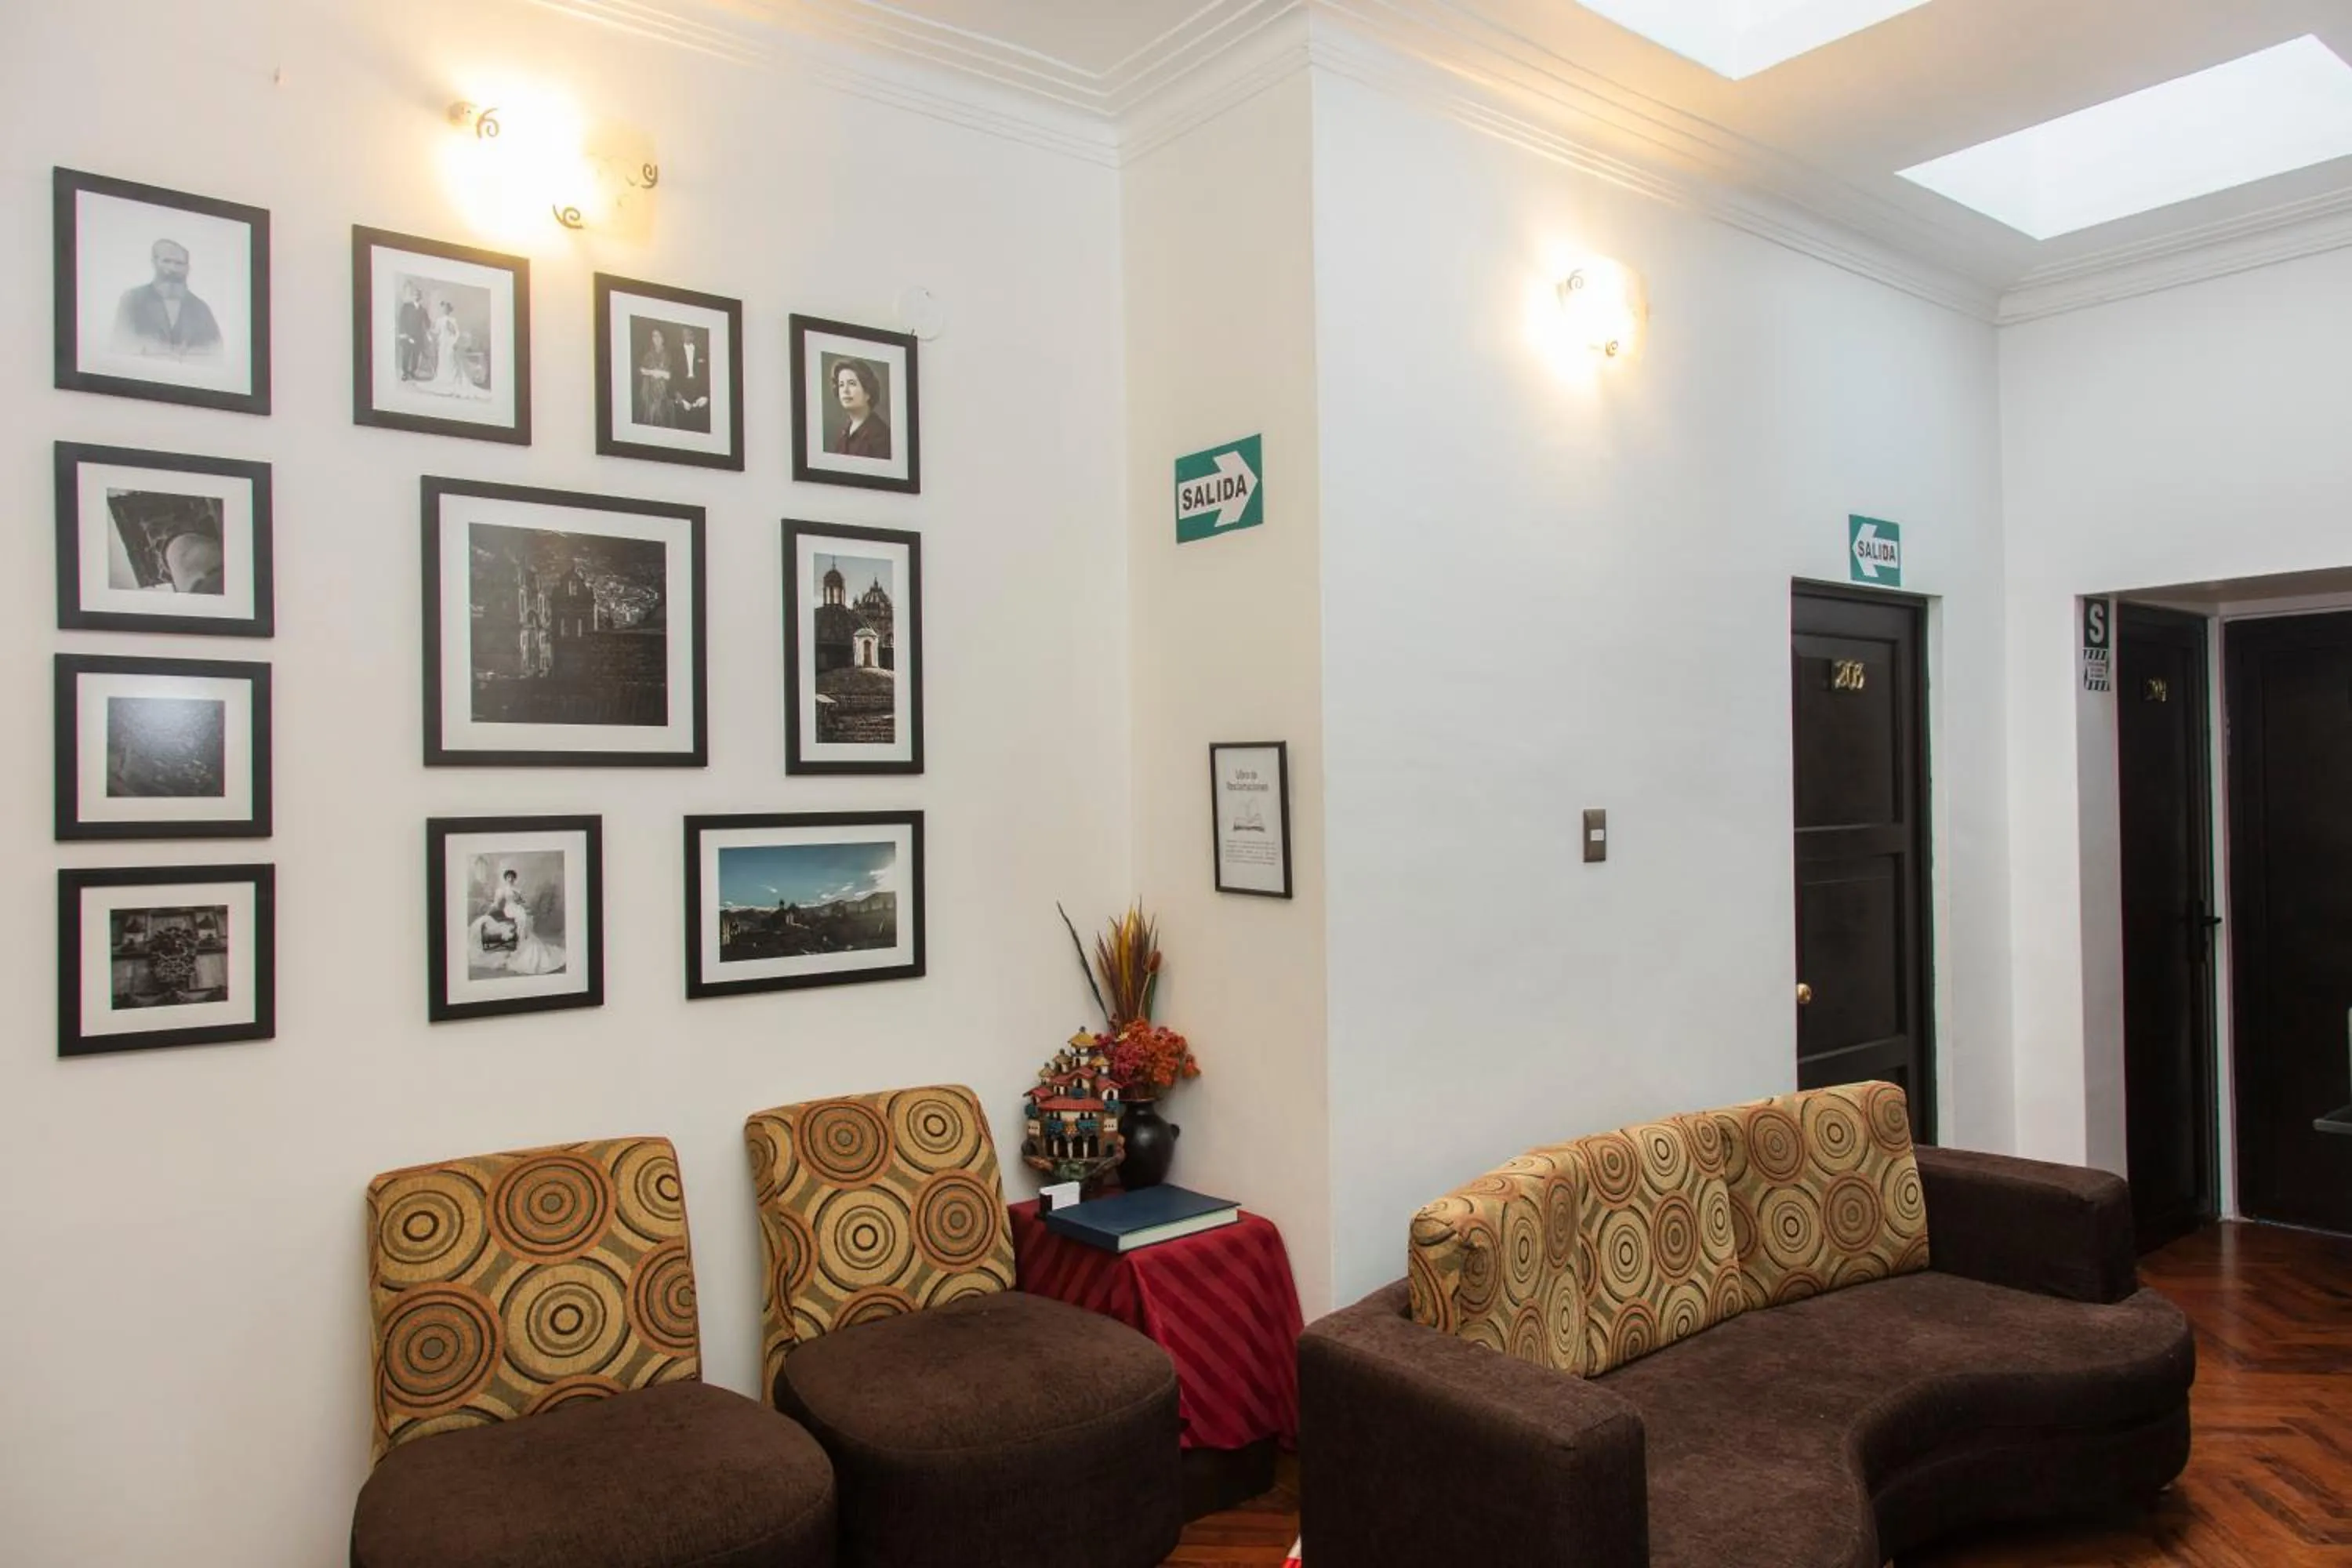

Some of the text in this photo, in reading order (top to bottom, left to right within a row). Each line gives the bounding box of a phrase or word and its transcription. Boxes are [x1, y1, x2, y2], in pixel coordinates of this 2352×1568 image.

[1182, 474, 1247, 510] SALIDA
[1857, 540, 1896, 562] SALIDA
[2089, 602, 2104, 644] S
